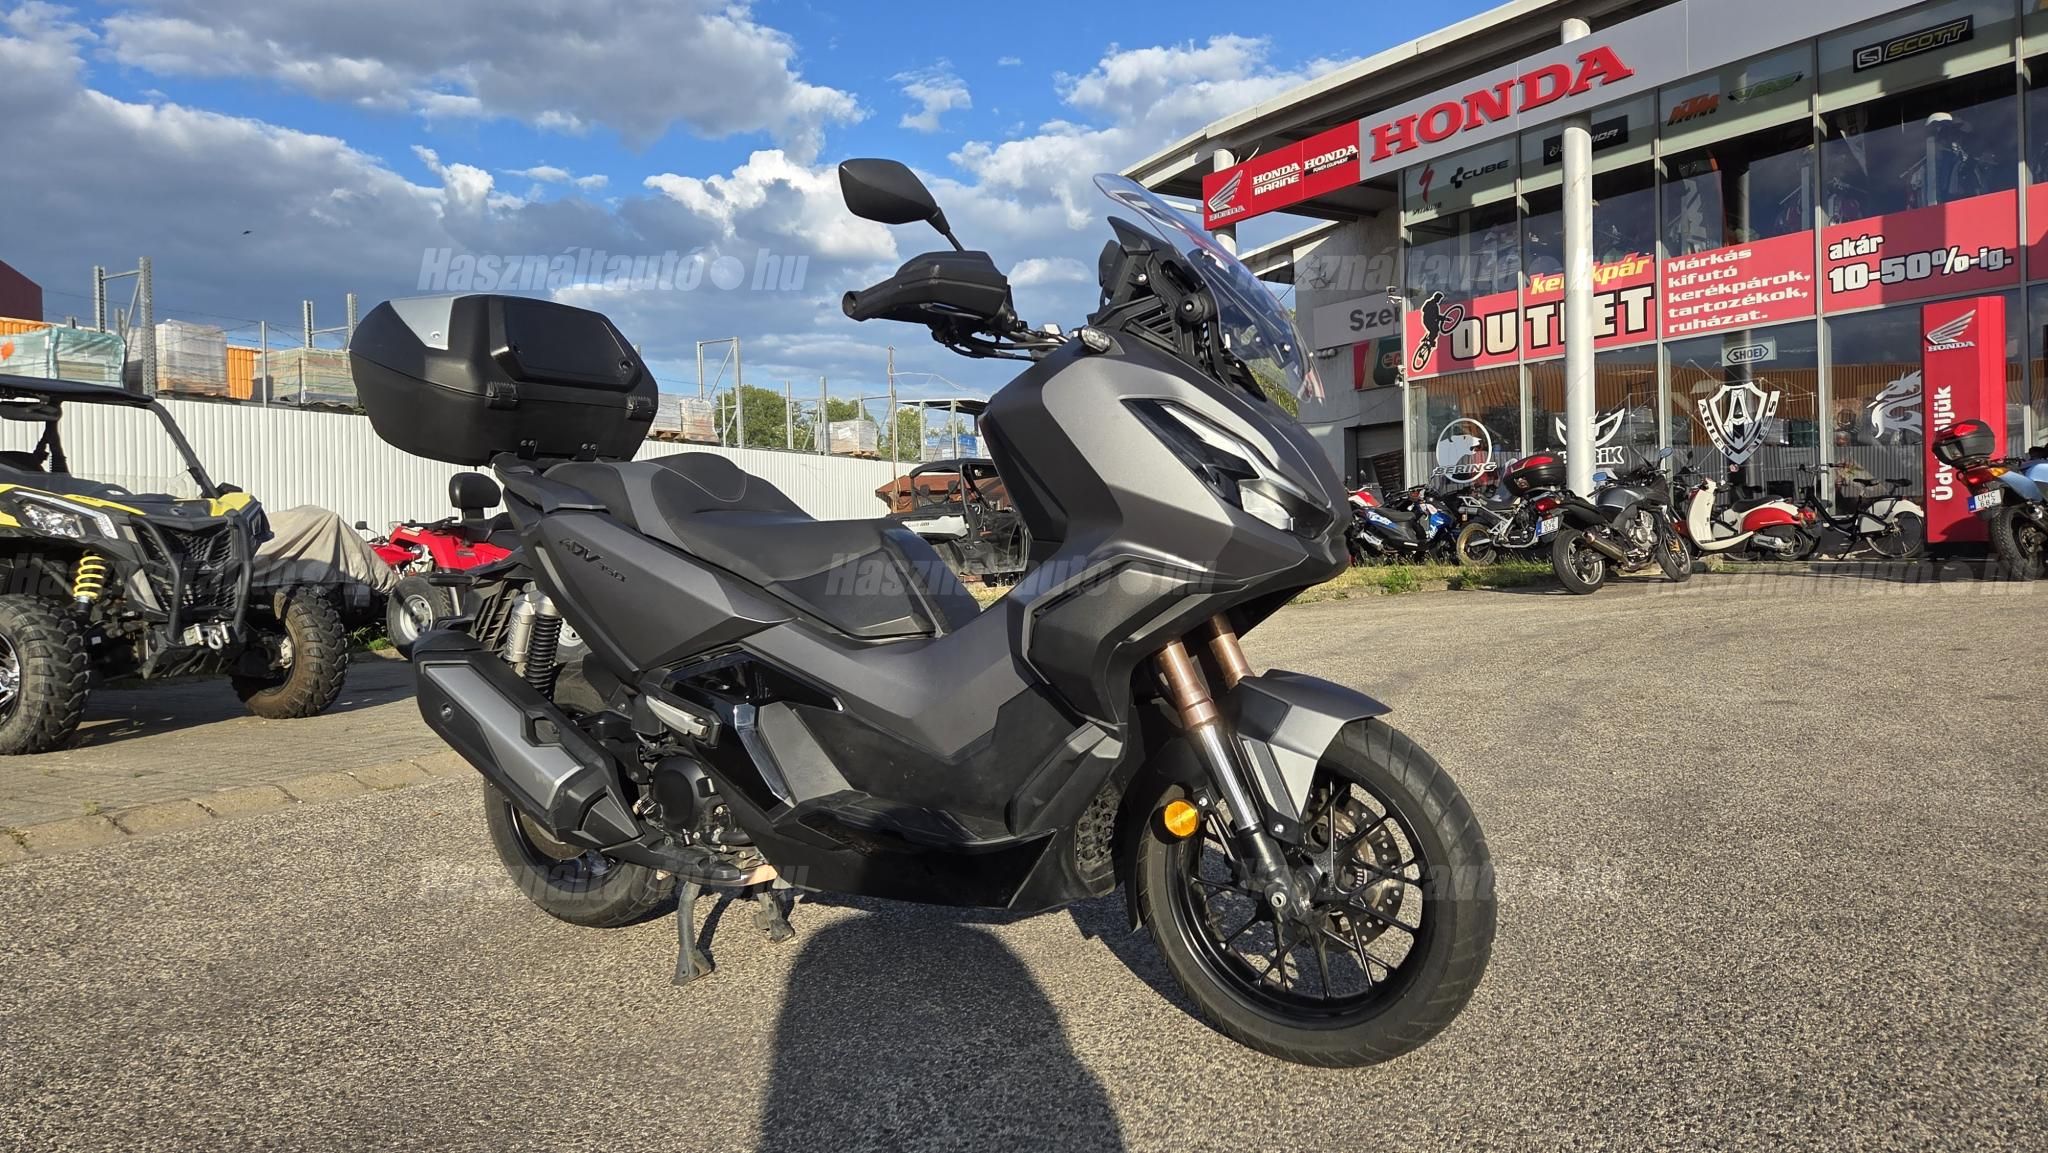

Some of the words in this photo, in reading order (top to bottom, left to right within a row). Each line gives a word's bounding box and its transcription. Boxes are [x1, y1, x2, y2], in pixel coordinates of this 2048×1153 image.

[1888, 25, 1964, 56] SCOTT
[1370, 45, 1635, 163] HONDA
[1304, 144, 1358, 170] HONDA
[1252, 162, 1301, 186] HONDA
[1462, 159, 1509, 181] CUBE
[1254, 173, 1300, 196] MARINE
[1209, 205, 1246, 222] HONDA
[1829, 234, 1885, 261] akár
[1668, 249, 1752, 273] Márkás
[1829, 246, 2013, 294] 10-50%-ig.
[1530, 257, 1650, 295] kekpár
[1668, 265, 1738, 289] kifutó
[1668, 270, 1811, 304] kerékpárok,
[1668, 287, 1808, 318] tartozékok,
[1450, 284, 1654, 361] OUTET
[1669, 310, 1768, 334] ruházat.
[1733, 348, 1763, 361] SHOEI
[1927, 340, 1976, 352] HONDA
[1931, 385, 1955, 501] Üdvljük
[1431, 462, 1498, 480] BERING
